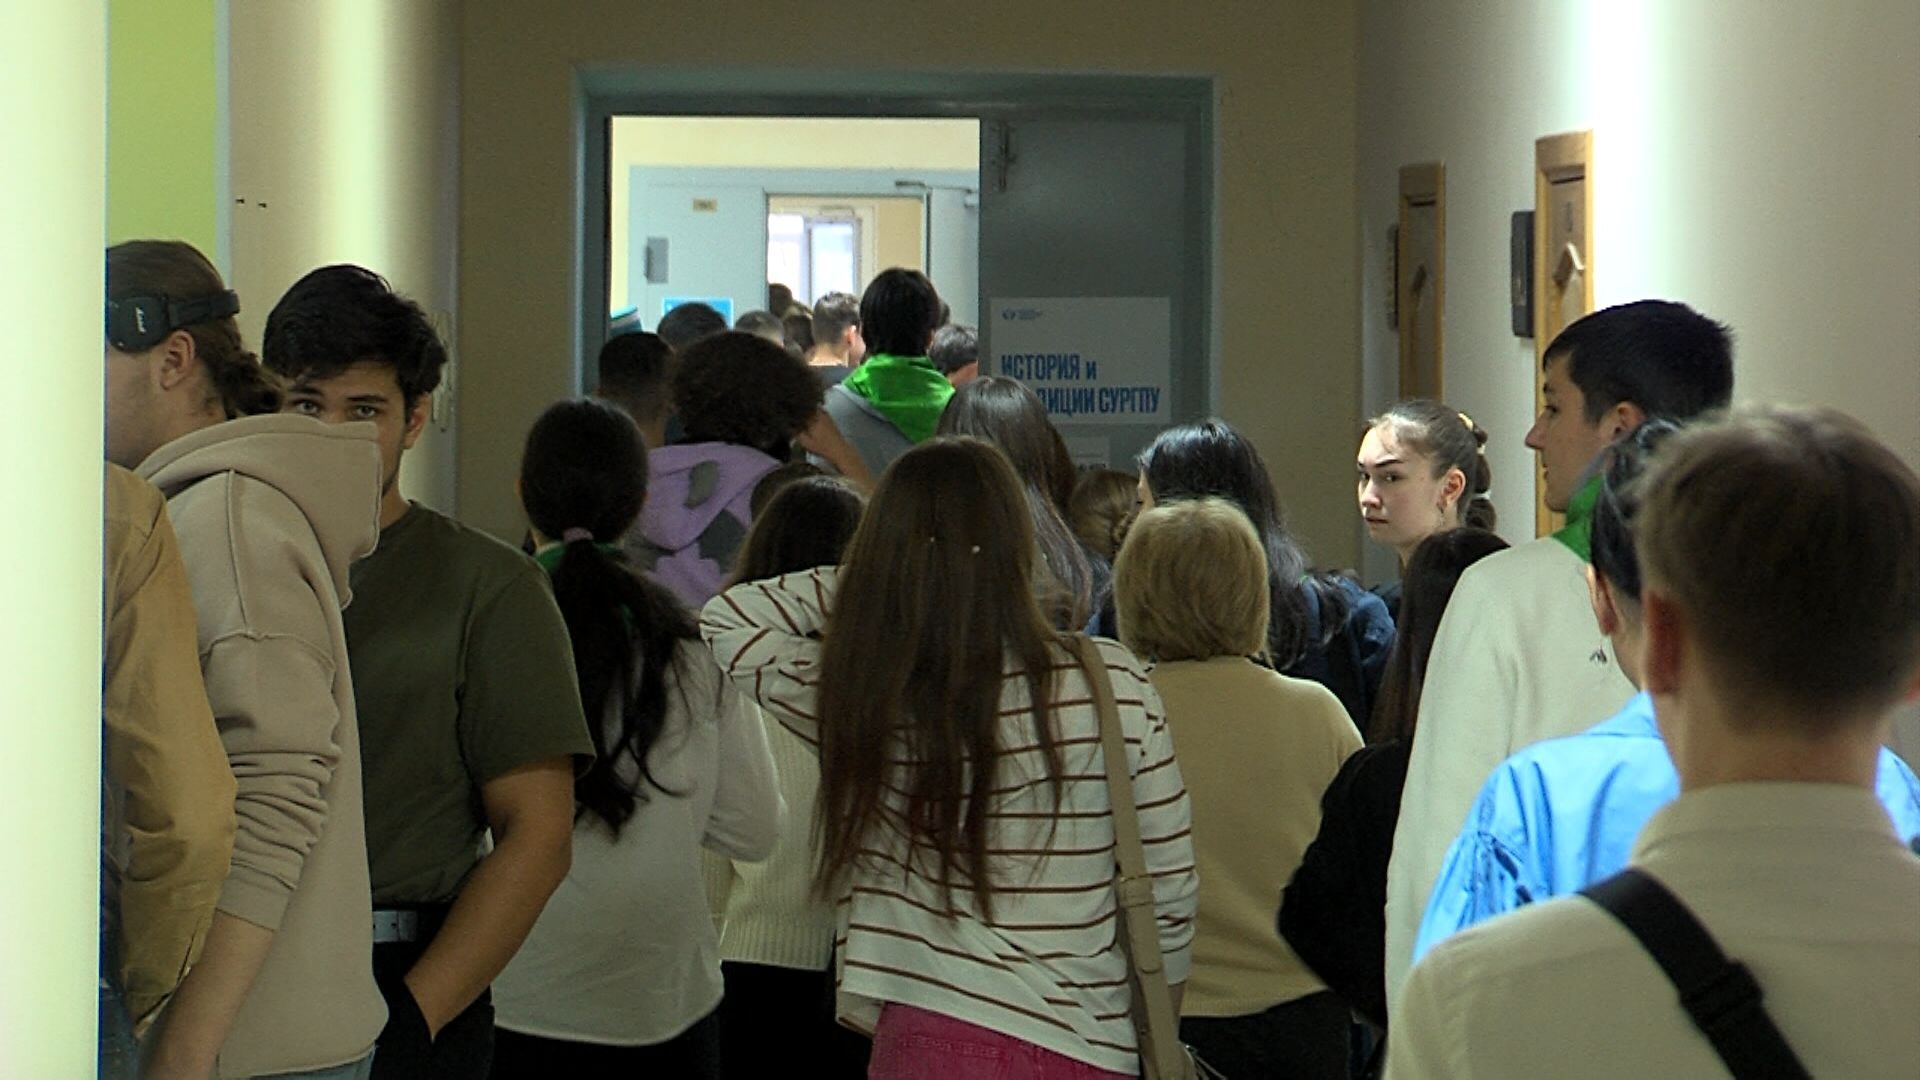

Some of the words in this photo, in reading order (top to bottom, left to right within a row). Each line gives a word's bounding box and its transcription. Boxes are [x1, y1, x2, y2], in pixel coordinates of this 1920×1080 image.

[1001, 352, 1080, 380] ИСТОРИЯ
[1086, 360, 1096, 380] и
[1036, 387, 1095, 416] ДИЦИИ
[1099, 386, 1160, 414] СУРГПУ
